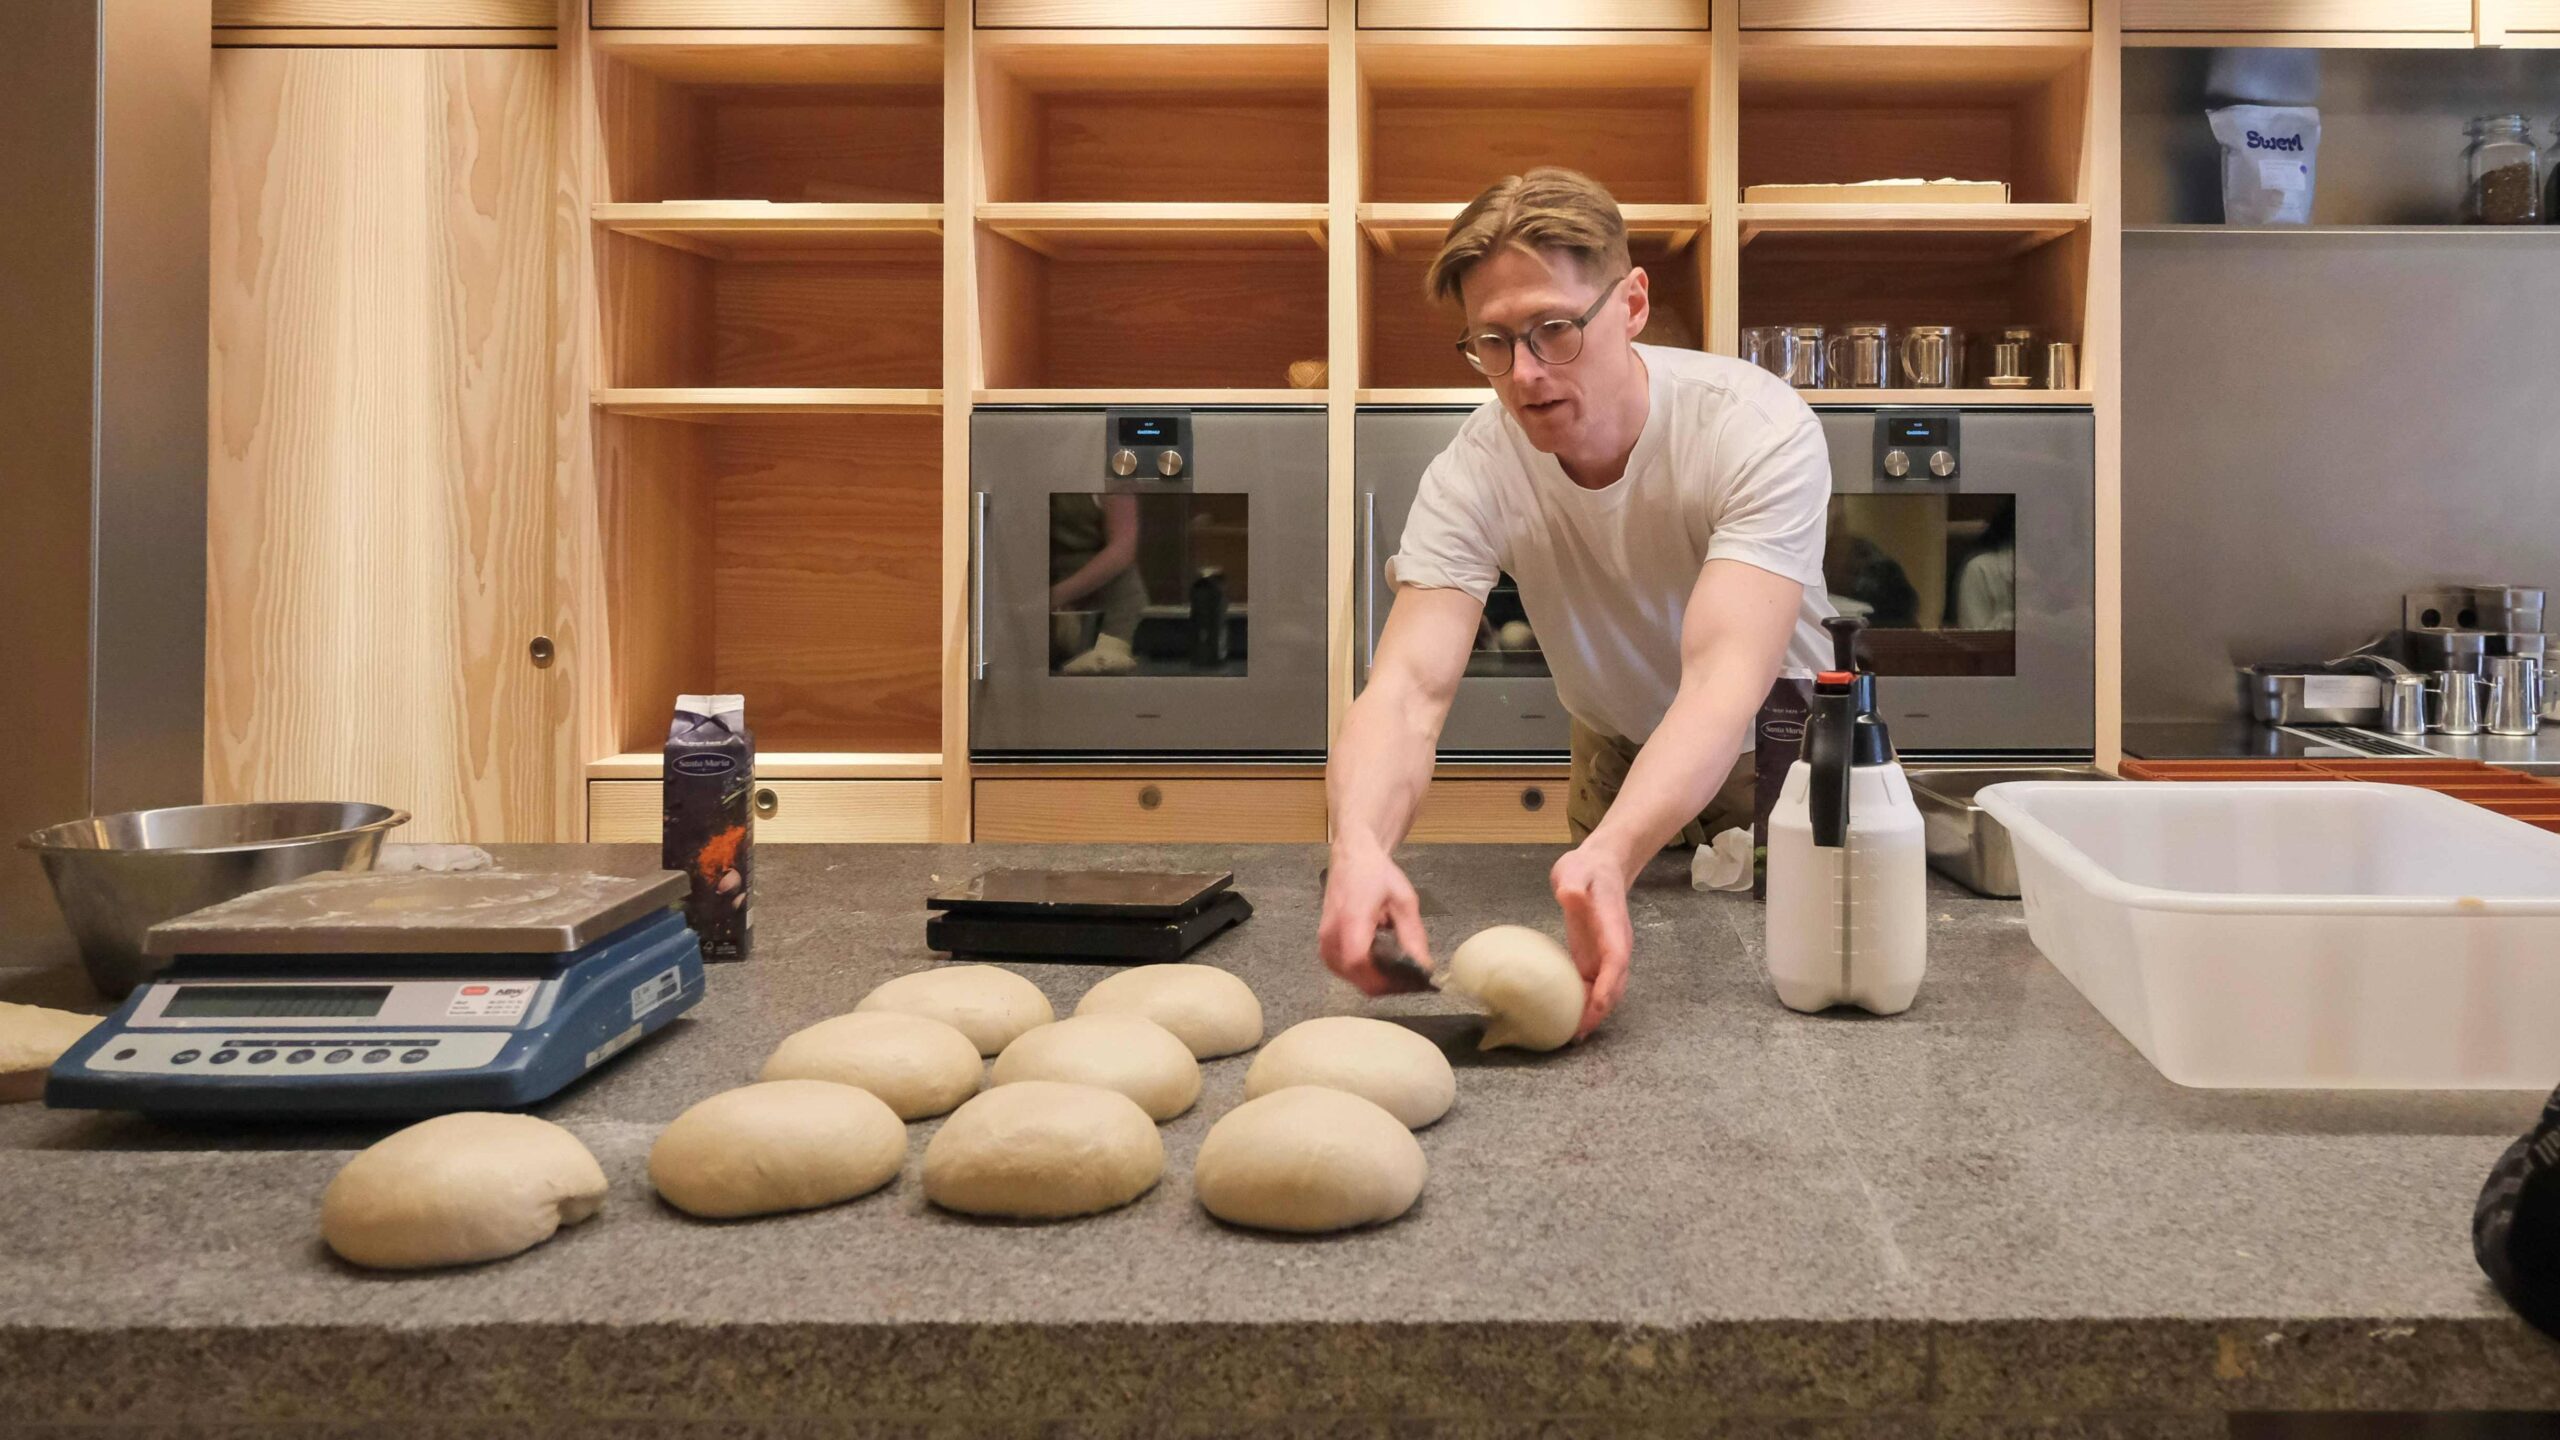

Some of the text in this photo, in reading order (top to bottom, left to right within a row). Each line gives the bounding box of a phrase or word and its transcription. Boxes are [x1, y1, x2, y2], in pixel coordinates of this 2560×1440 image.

[1765, 725, 1785, 734] Santa
[679, 759, 731, 768] Santa Maria
